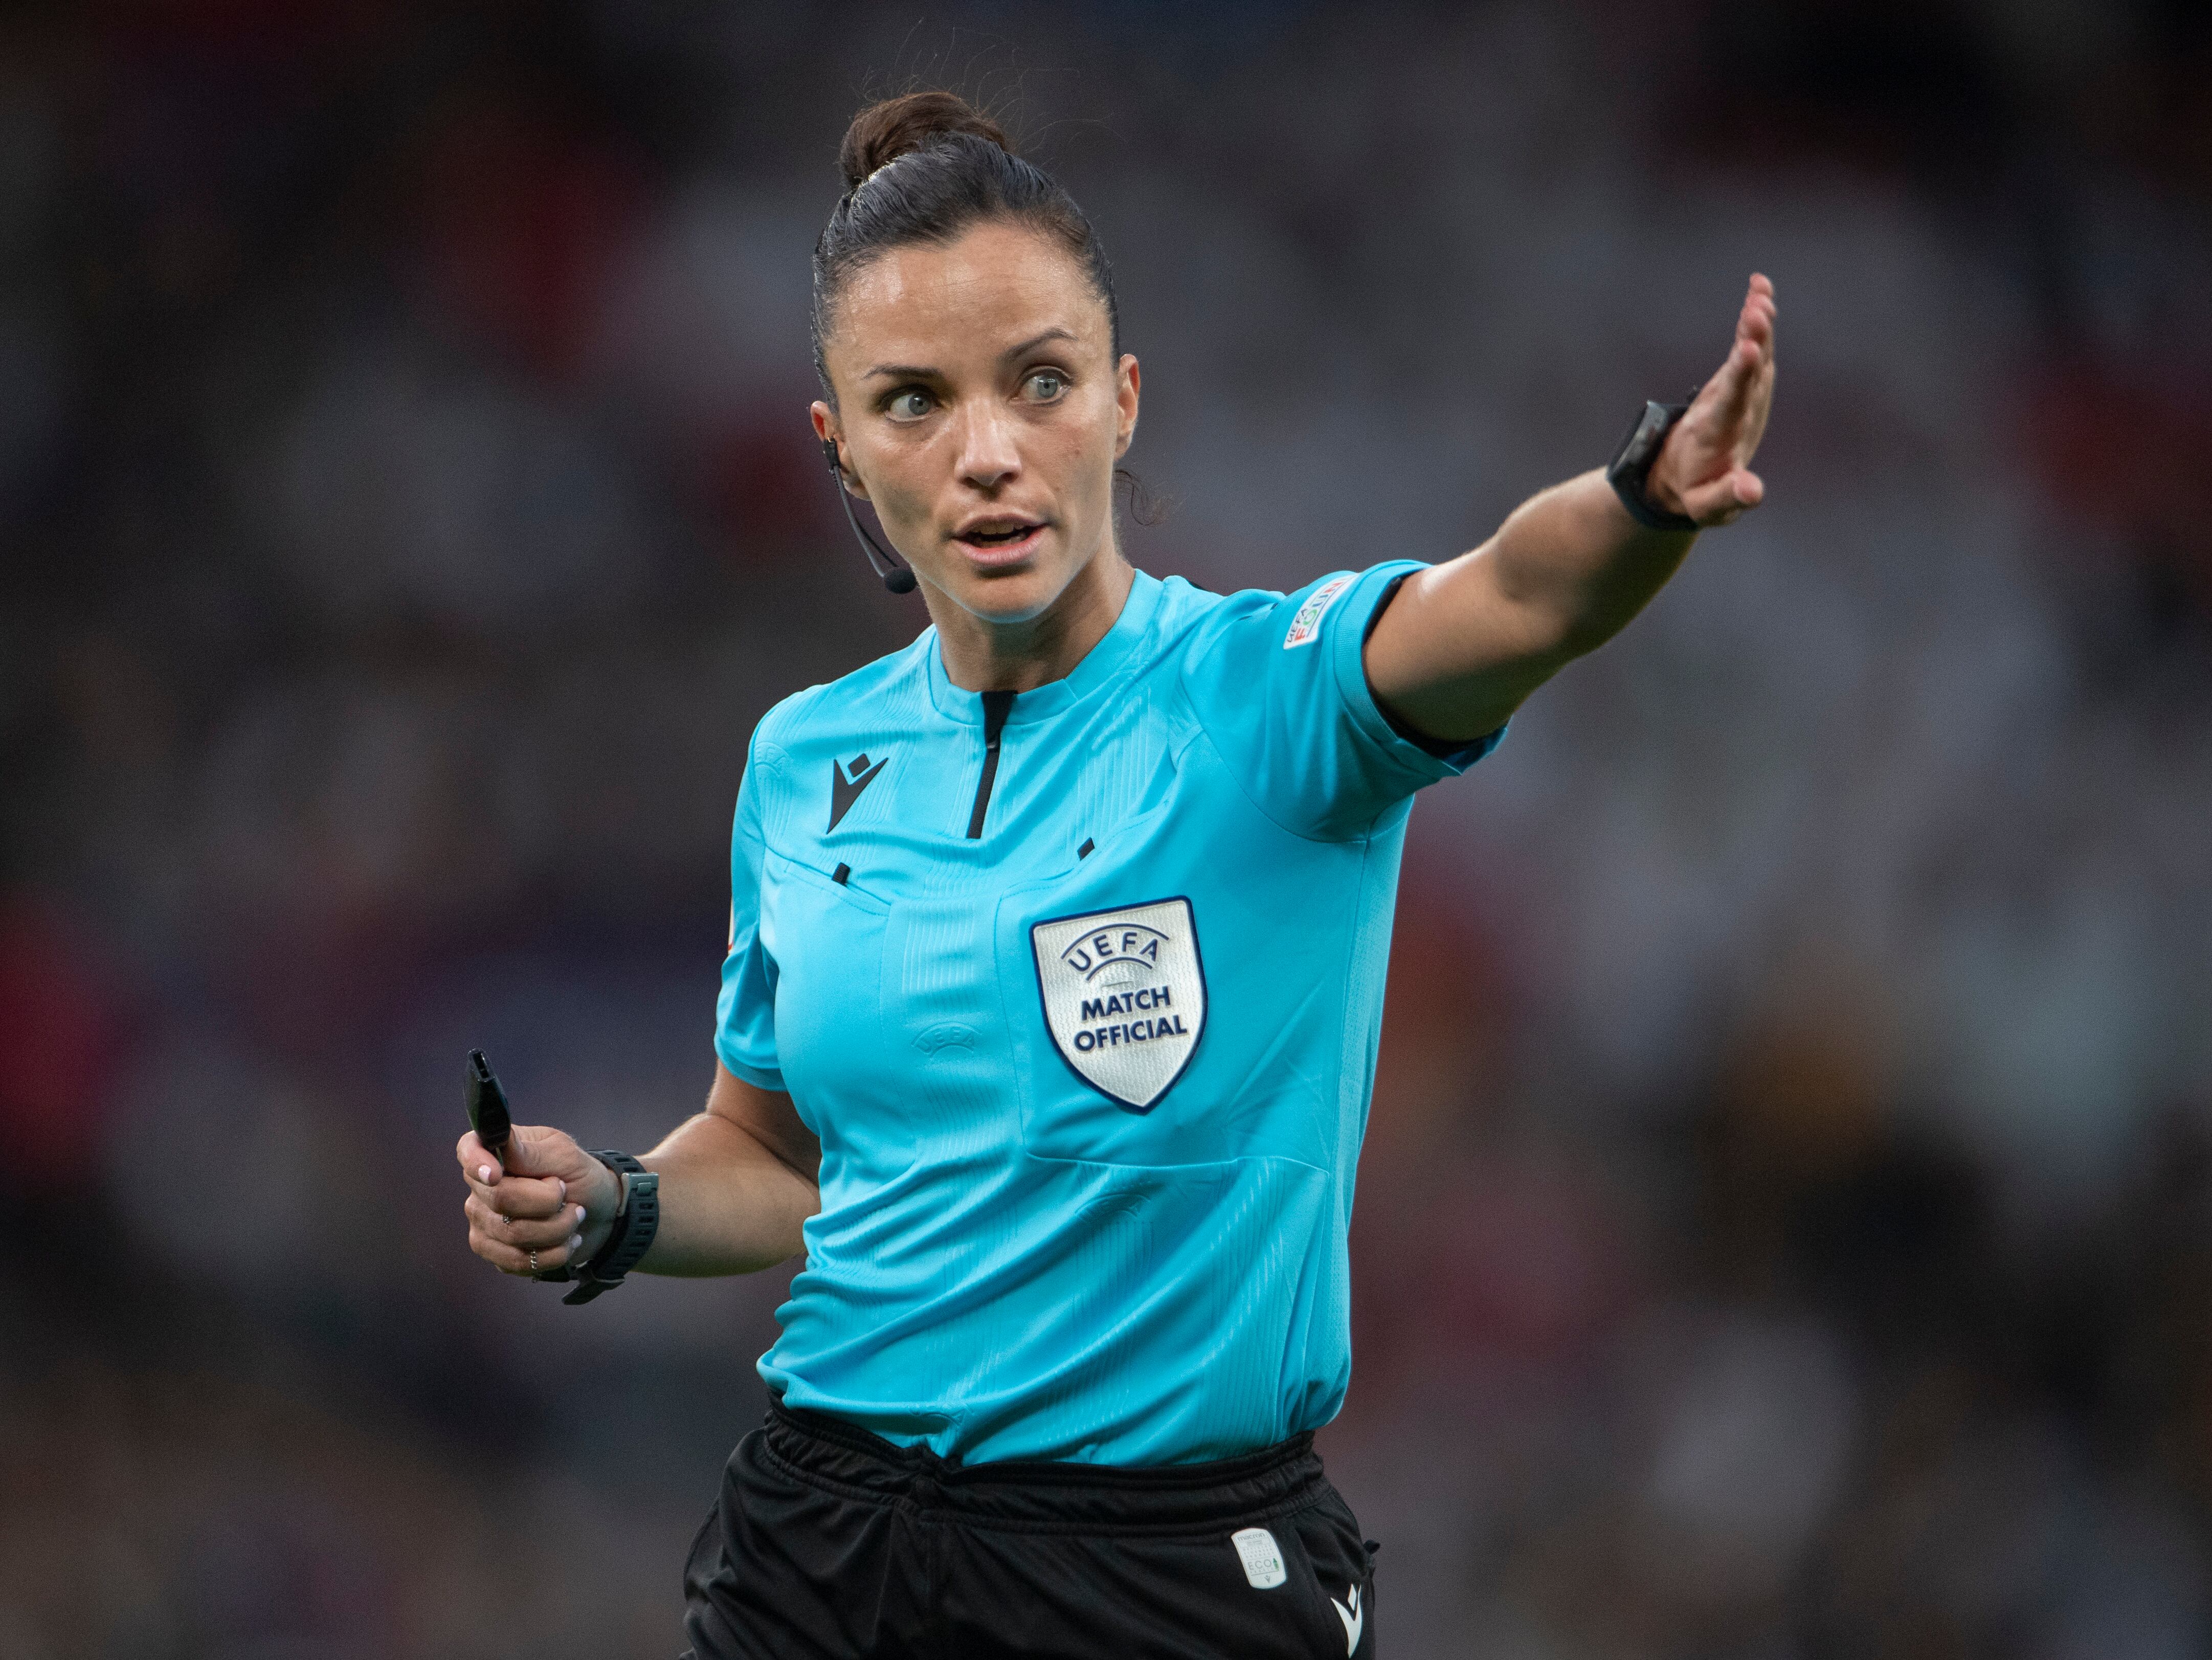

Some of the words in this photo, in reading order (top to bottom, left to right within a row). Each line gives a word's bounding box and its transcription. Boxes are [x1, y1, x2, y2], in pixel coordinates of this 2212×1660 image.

[1287, 608, 1308, 643] UEFA
[1068, 932, 1158, 972] UEFA
[1081, 986, 1171, 1021] MATCH
[916, 1027, 975, 1054] UEFA
[1074, 1014, 1187, 1051] OFFICIAL
[1237, 1533, 1265, 1541] macron
[1248, 1559, 1272, 1570] ECO
